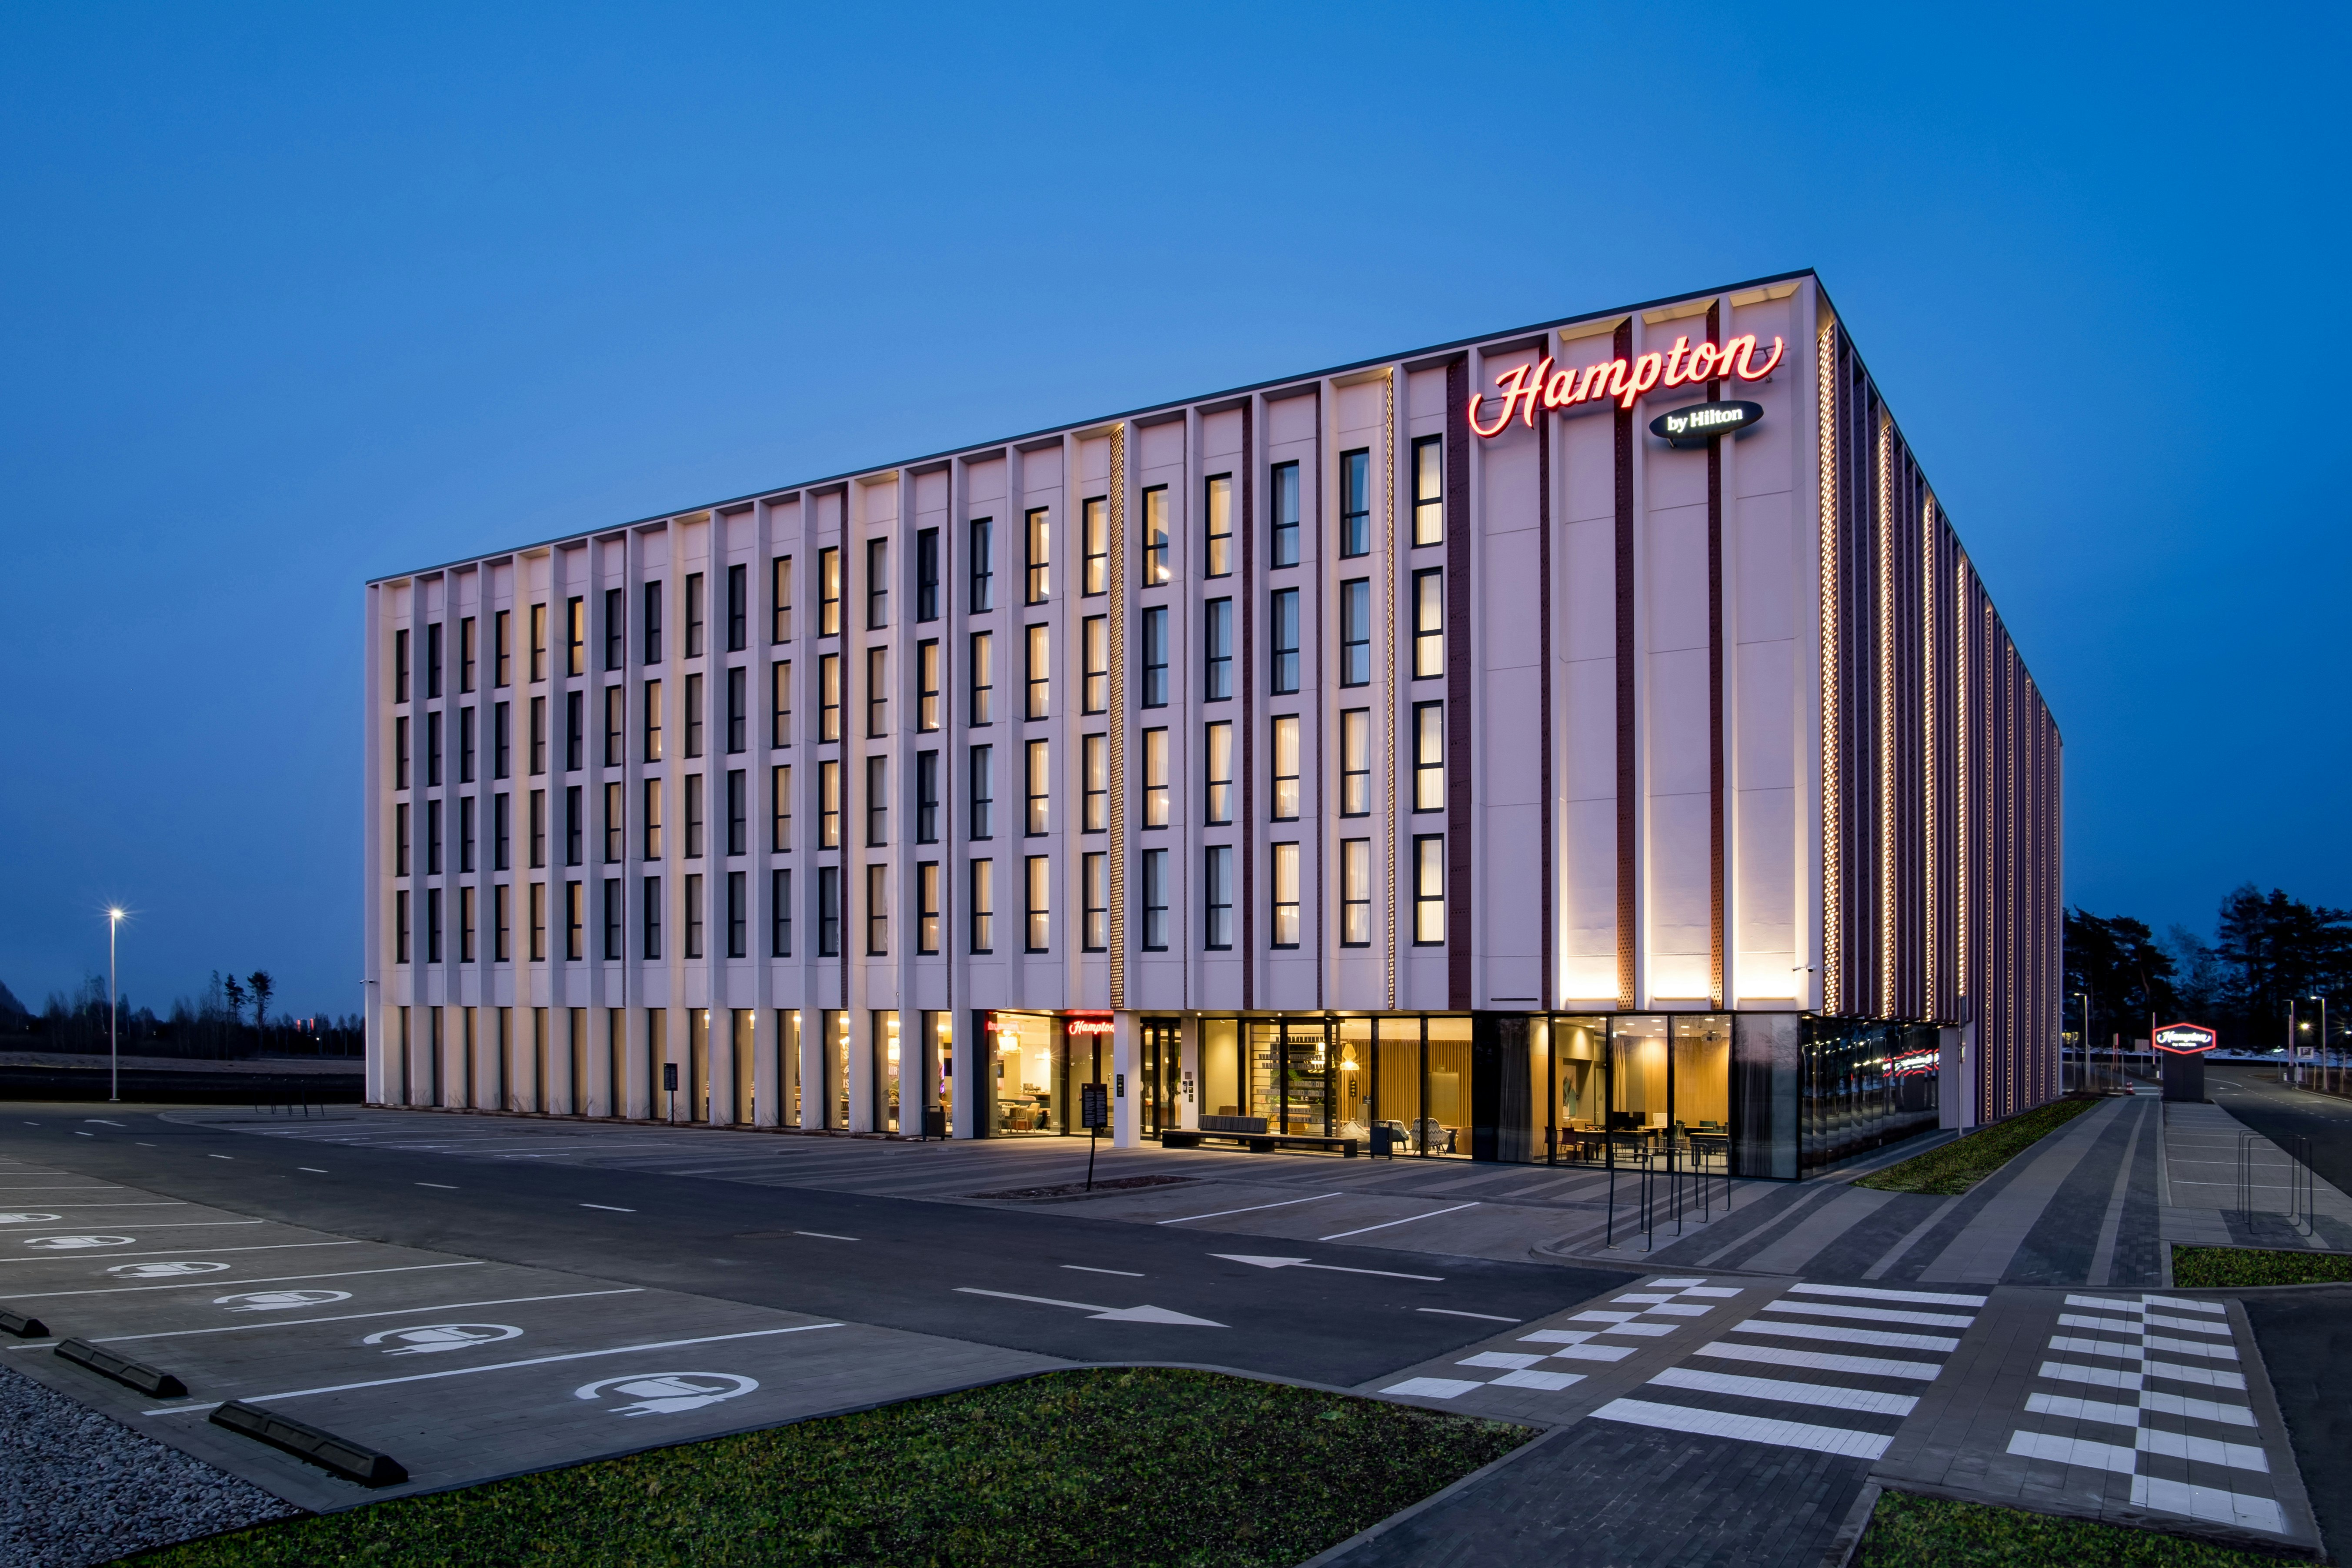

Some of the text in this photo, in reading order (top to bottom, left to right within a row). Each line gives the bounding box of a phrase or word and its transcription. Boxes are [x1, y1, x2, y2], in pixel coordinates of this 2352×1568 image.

[1469, 335, 1783, 437] Hampton
[1667, 408, 1743, 433] by Hilton
